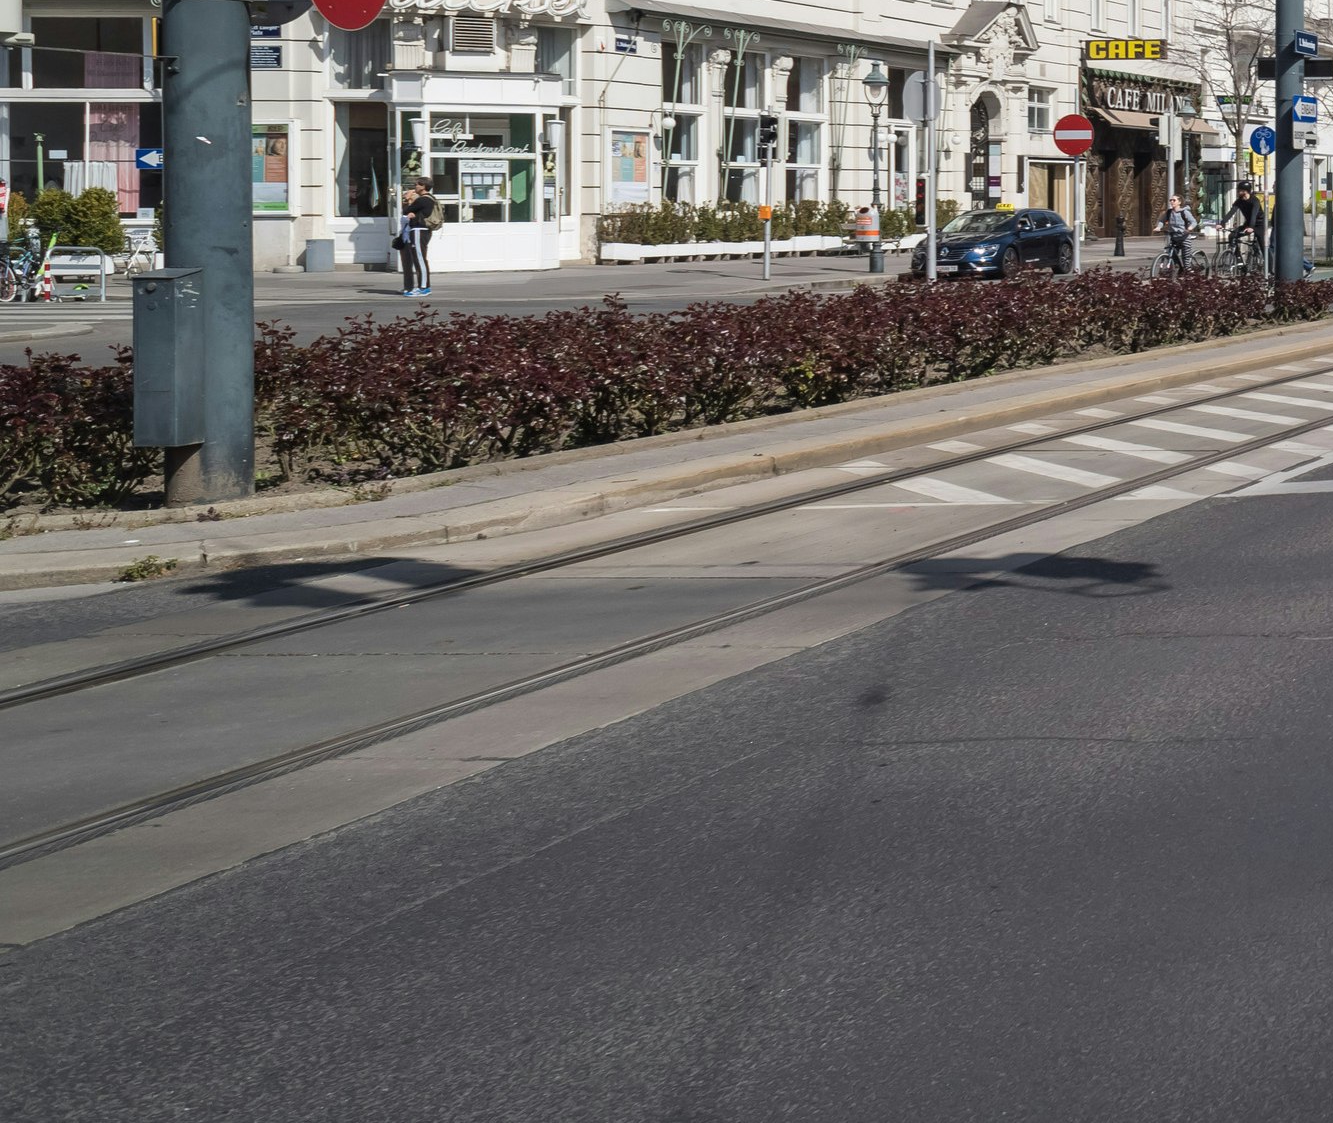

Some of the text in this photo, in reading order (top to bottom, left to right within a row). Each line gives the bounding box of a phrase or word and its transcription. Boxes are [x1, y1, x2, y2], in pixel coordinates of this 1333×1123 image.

[1089, 40, 1161, 59] CAFE
[1107, 86, 1187, 115] CAFE MILAN
[450, 140, 530, 154] Restaurant
